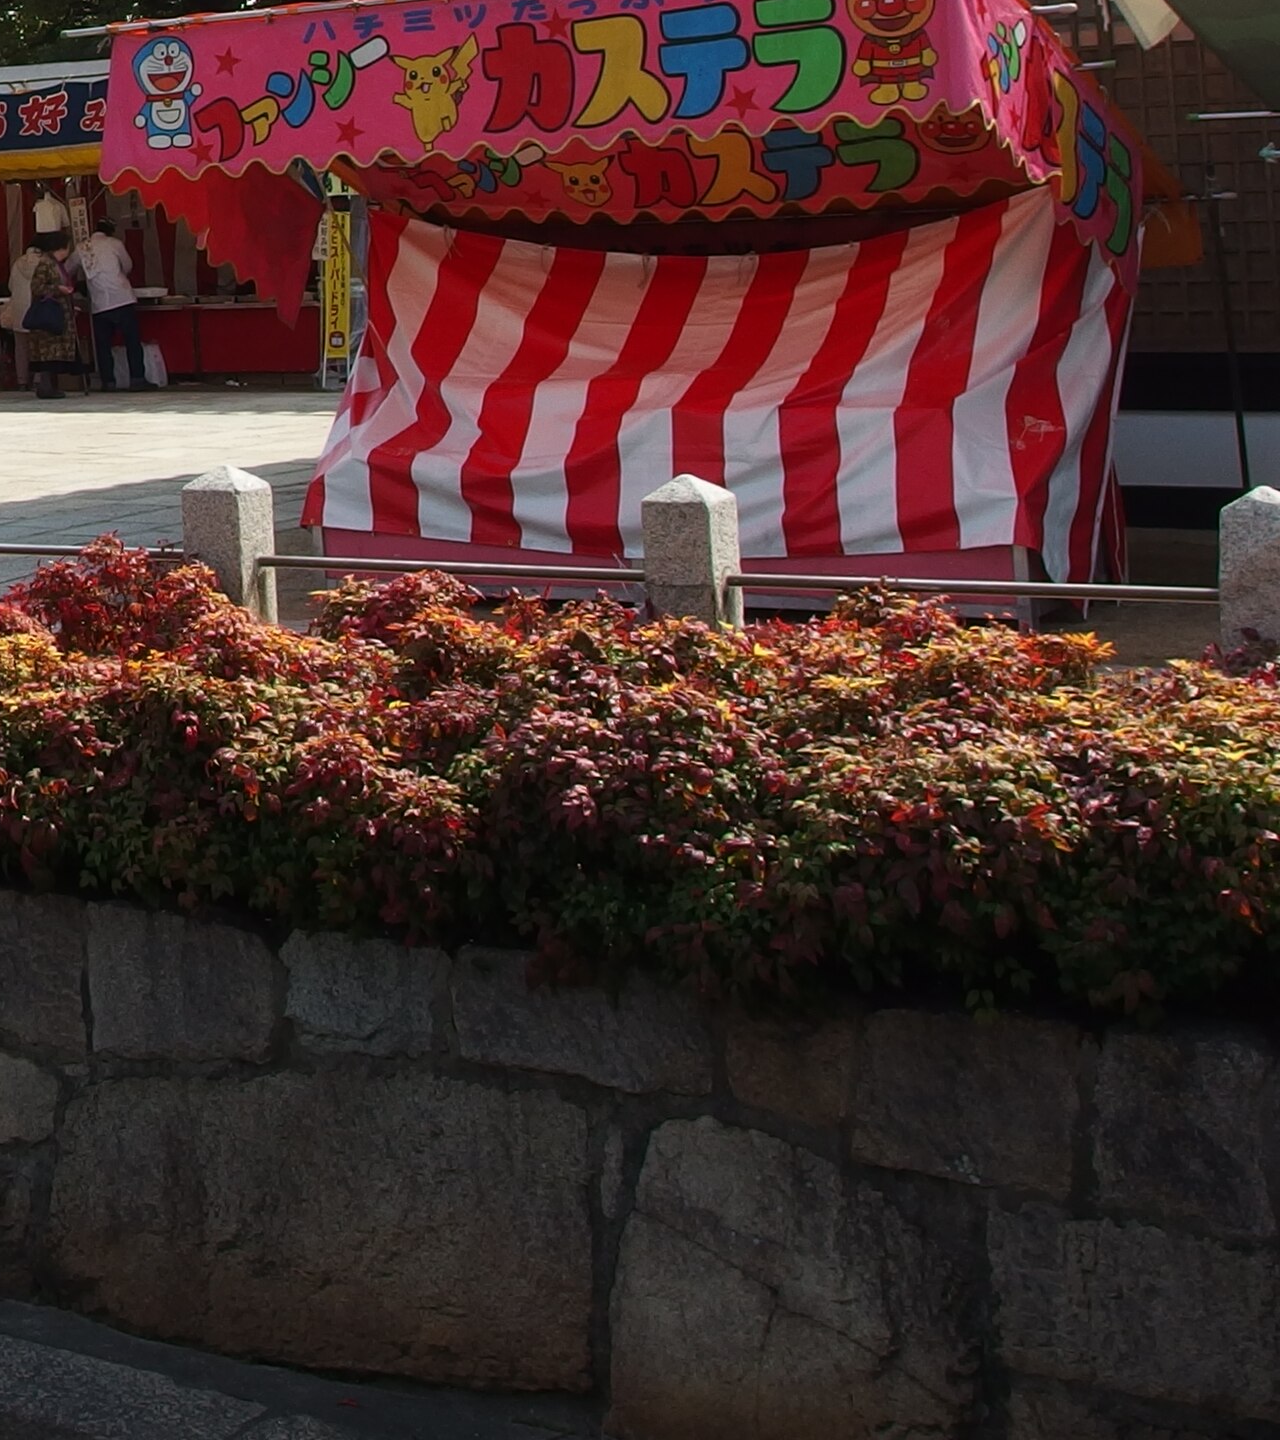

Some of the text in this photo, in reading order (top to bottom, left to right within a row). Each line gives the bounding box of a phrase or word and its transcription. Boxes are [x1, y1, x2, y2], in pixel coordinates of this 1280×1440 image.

[194, 35, 390, 162] ファンシー
[618, 116, 922, 208] カステラ
